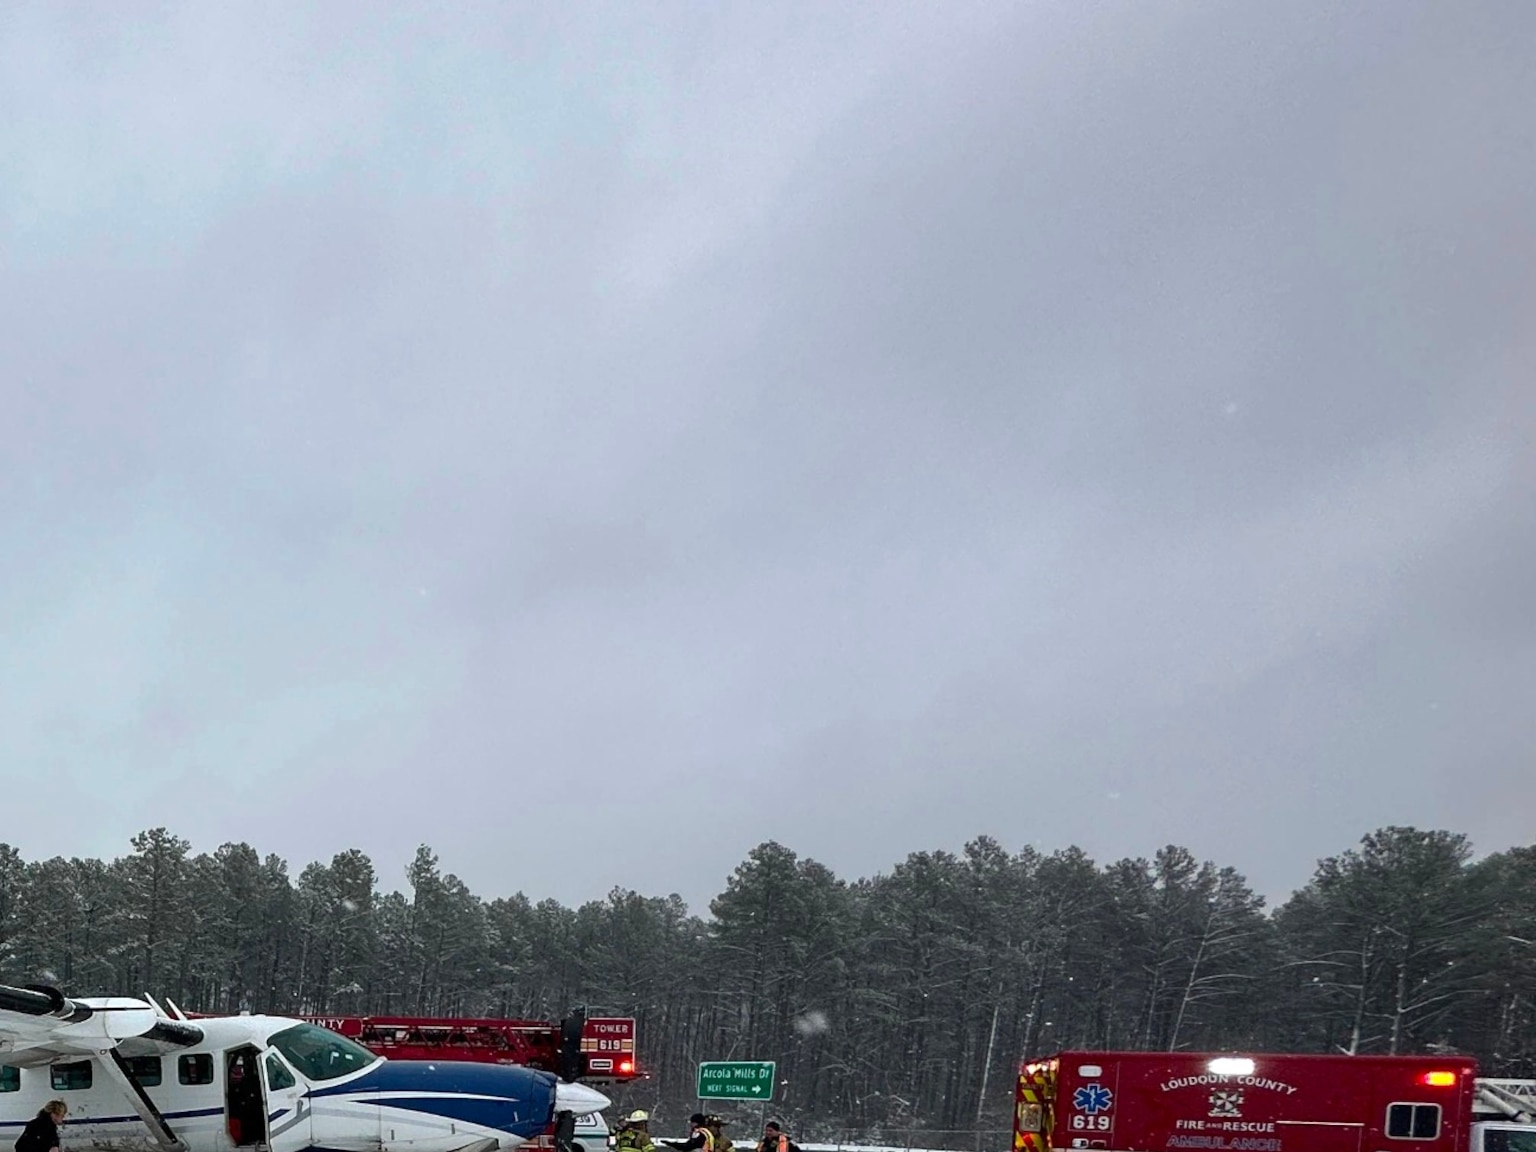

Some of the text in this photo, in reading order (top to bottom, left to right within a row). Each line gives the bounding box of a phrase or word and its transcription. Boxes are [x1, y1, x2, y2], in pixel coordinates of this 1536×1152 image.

[593, 1024, 629, 1034] TOWER
[599, 1039, 621, 1050] 619
[703, 1068, 770, 1079] Arcola Mills Dr
[707, 1084, 748, 1093] NEXT SIGNAL
[1160, 1074, 1297, 1095] LOUDOUN COUNTY
[1073, 1115, 1110, 1130] 619
[1176, 1119, 1206, 1130] FIRE
[1223, 1121, 1275, 1132] RESCUE
[1166, 1135, 1282, 1152] AMBULANCE
